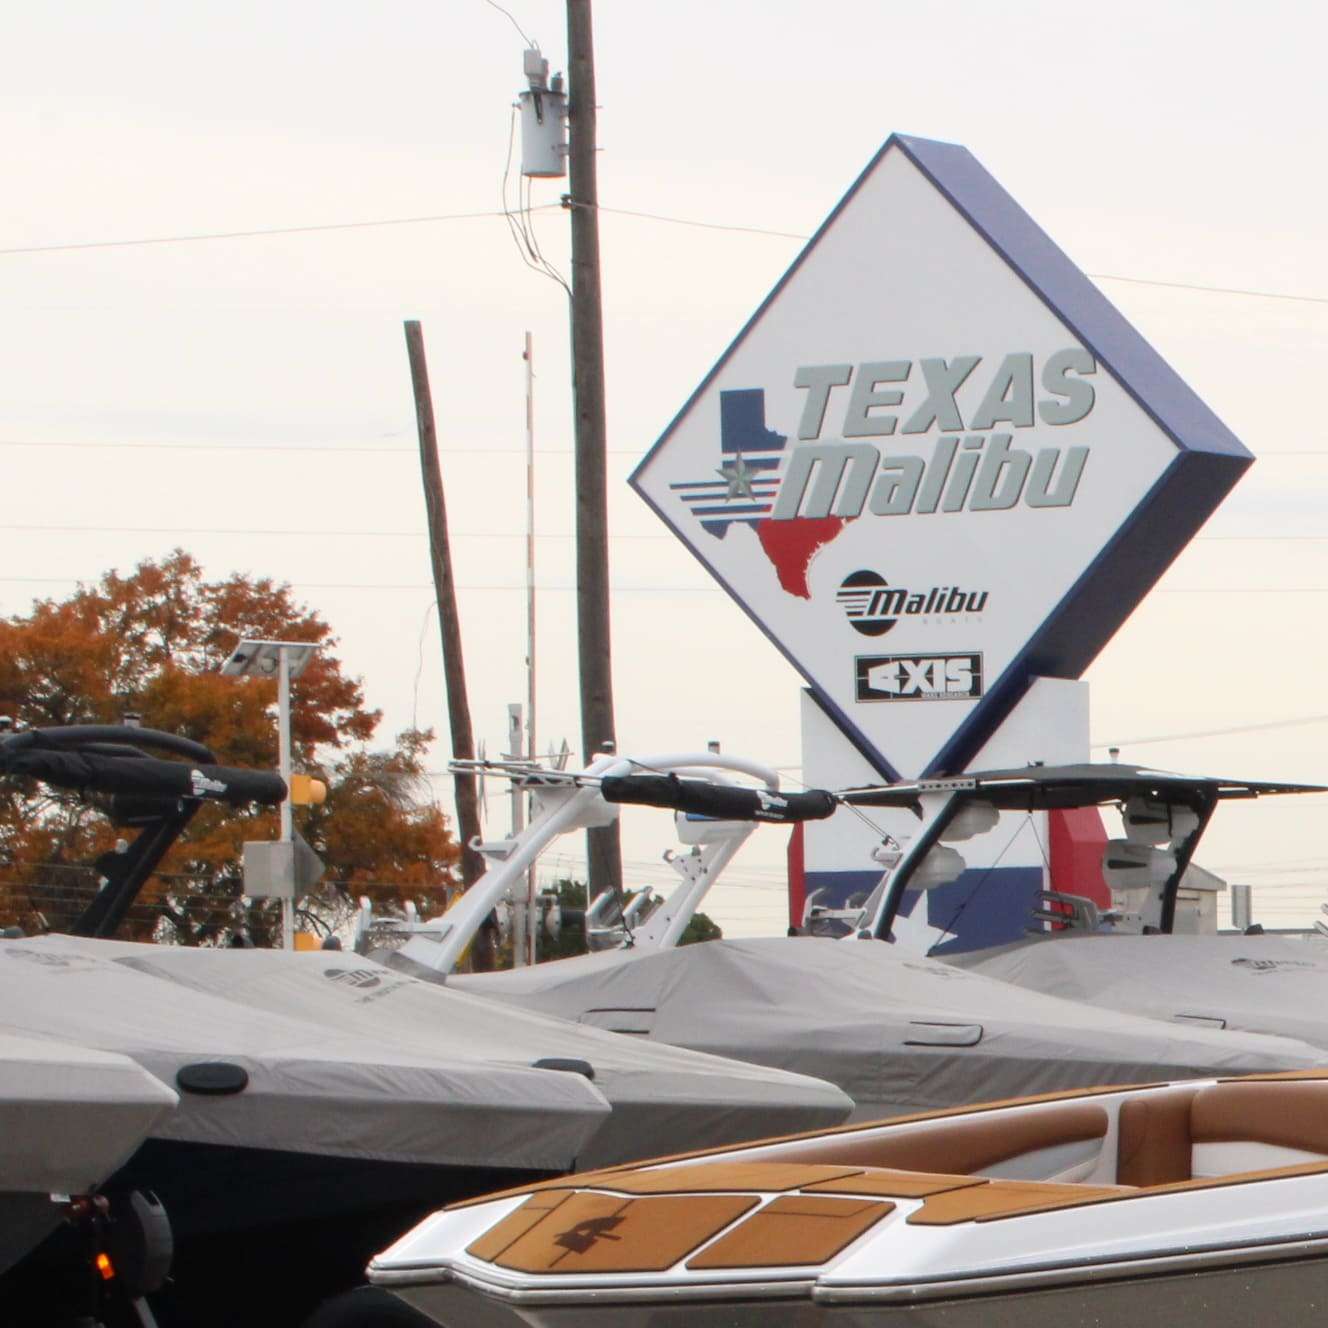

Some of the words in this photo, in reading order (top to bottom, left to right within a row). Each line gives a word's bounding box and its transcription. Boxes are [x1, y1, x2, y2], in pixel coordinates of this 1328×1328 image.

[794, 348, 1097, 441] TEXAS
[771, 433, 1091, 521] Malibu
[866, 587, 989, 617] Malibu
[867, 657, 972, 695] AXIS
